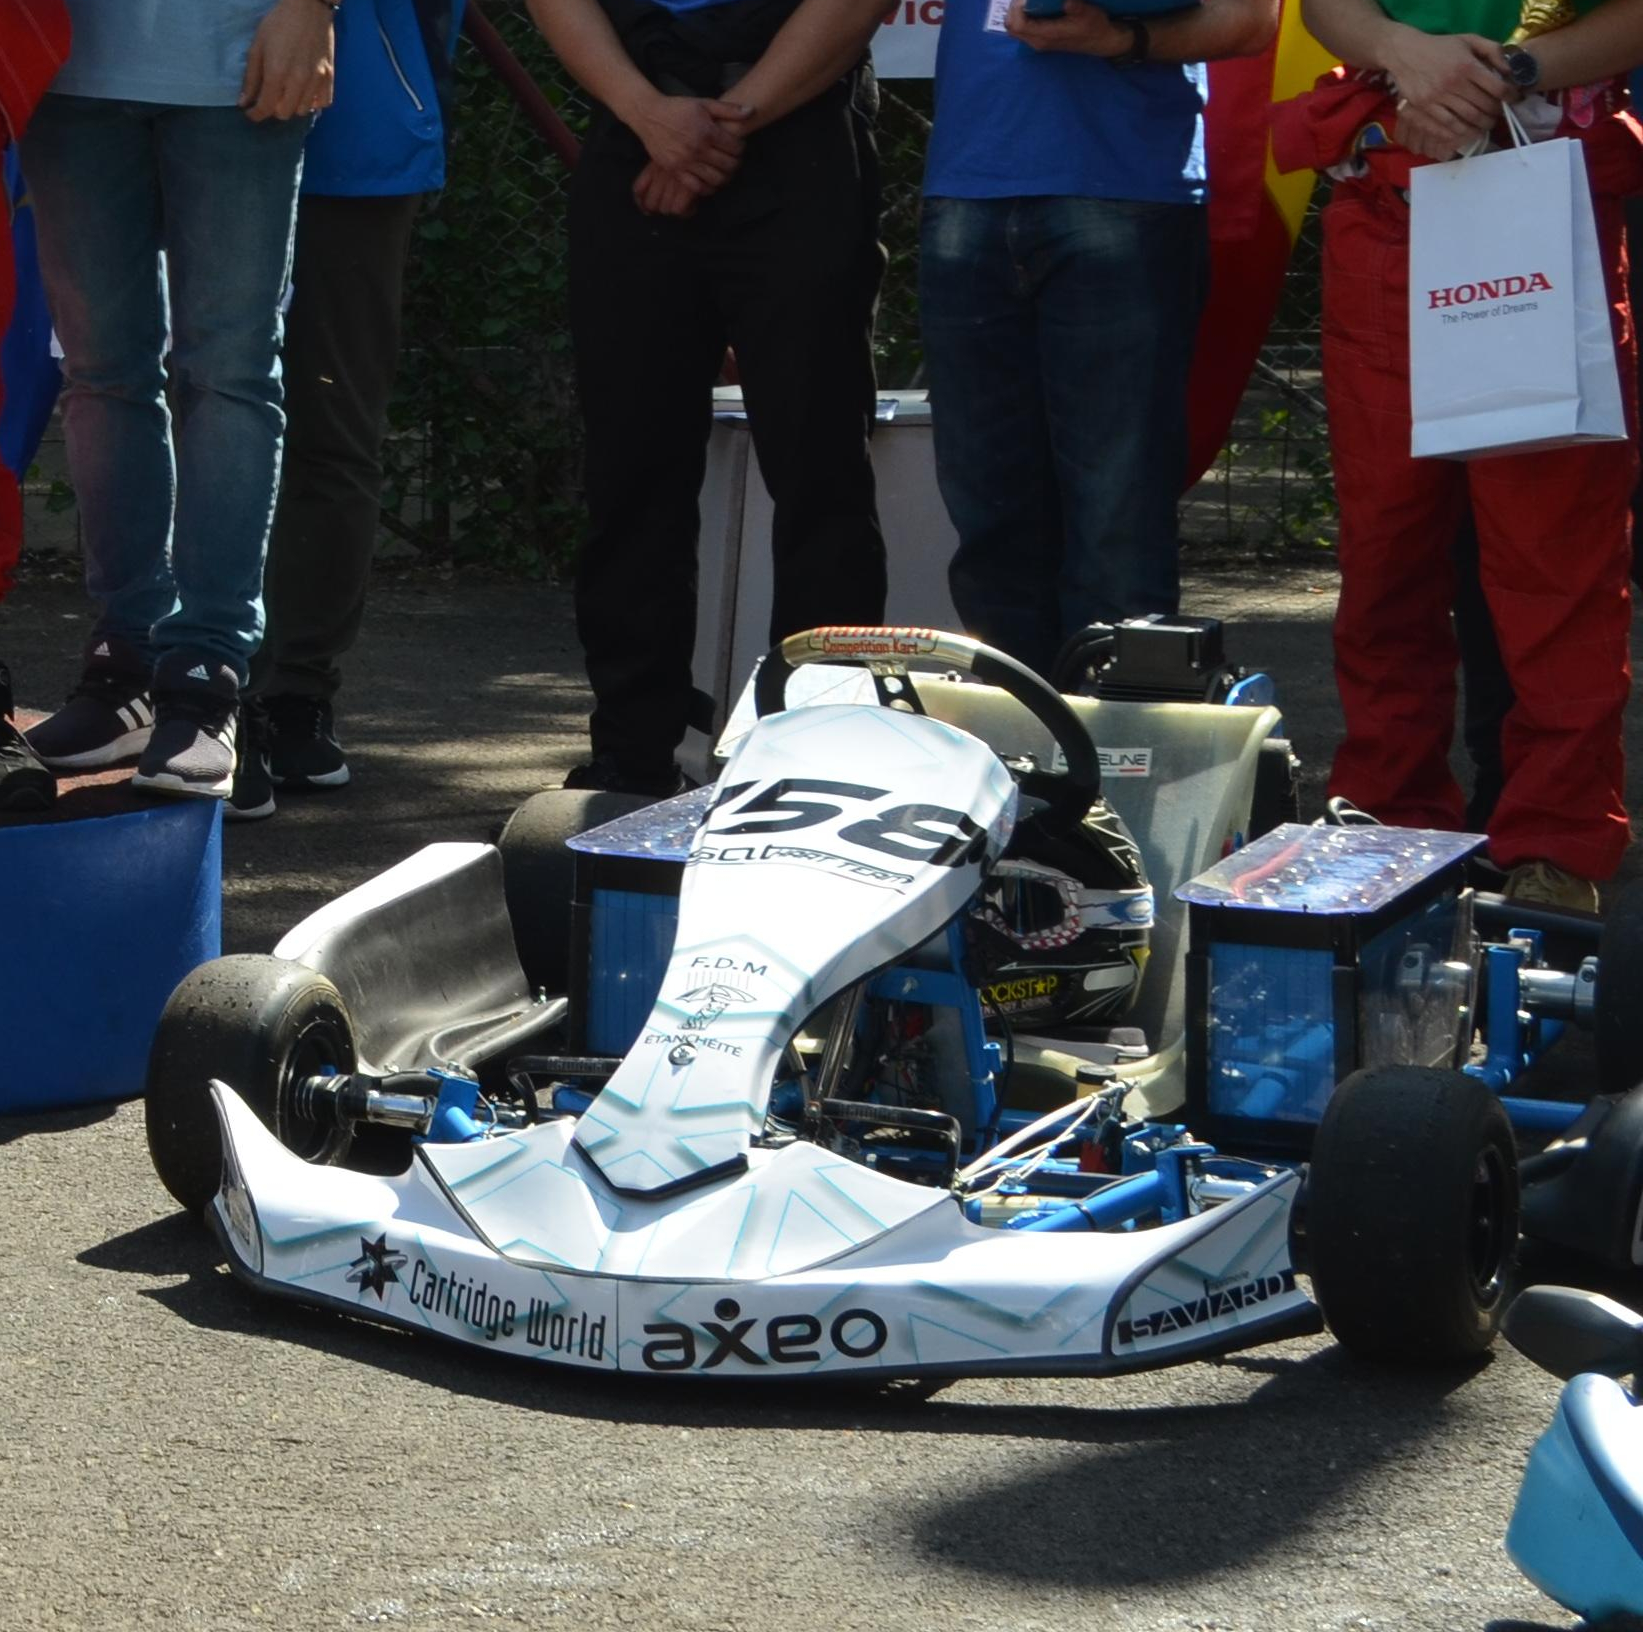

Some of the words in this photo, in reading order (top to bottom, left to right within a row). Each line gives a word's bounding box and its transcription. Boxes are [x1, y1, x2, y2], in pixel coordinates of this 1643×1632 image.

[1428, 272, 1553, 310] HONDA
[1442, 312, 1459, 324] The
[1461, 308, 1490, 321] Power
[1491, 305, 1501, 317] of
[1502, 302, 1539, 315] Dreams
[823, 639, 891, 654] Competition
[892, 638, 919, 654] Kart
[690, 956, 769, 977] F.D.M
[408, 1258, 517, 1342] Cartridge
[526, 1297, 607, 1362] World
[1128, 1272, 1289, 1338] SAVIARD
[642, 1306, 888, 1371] axeo
